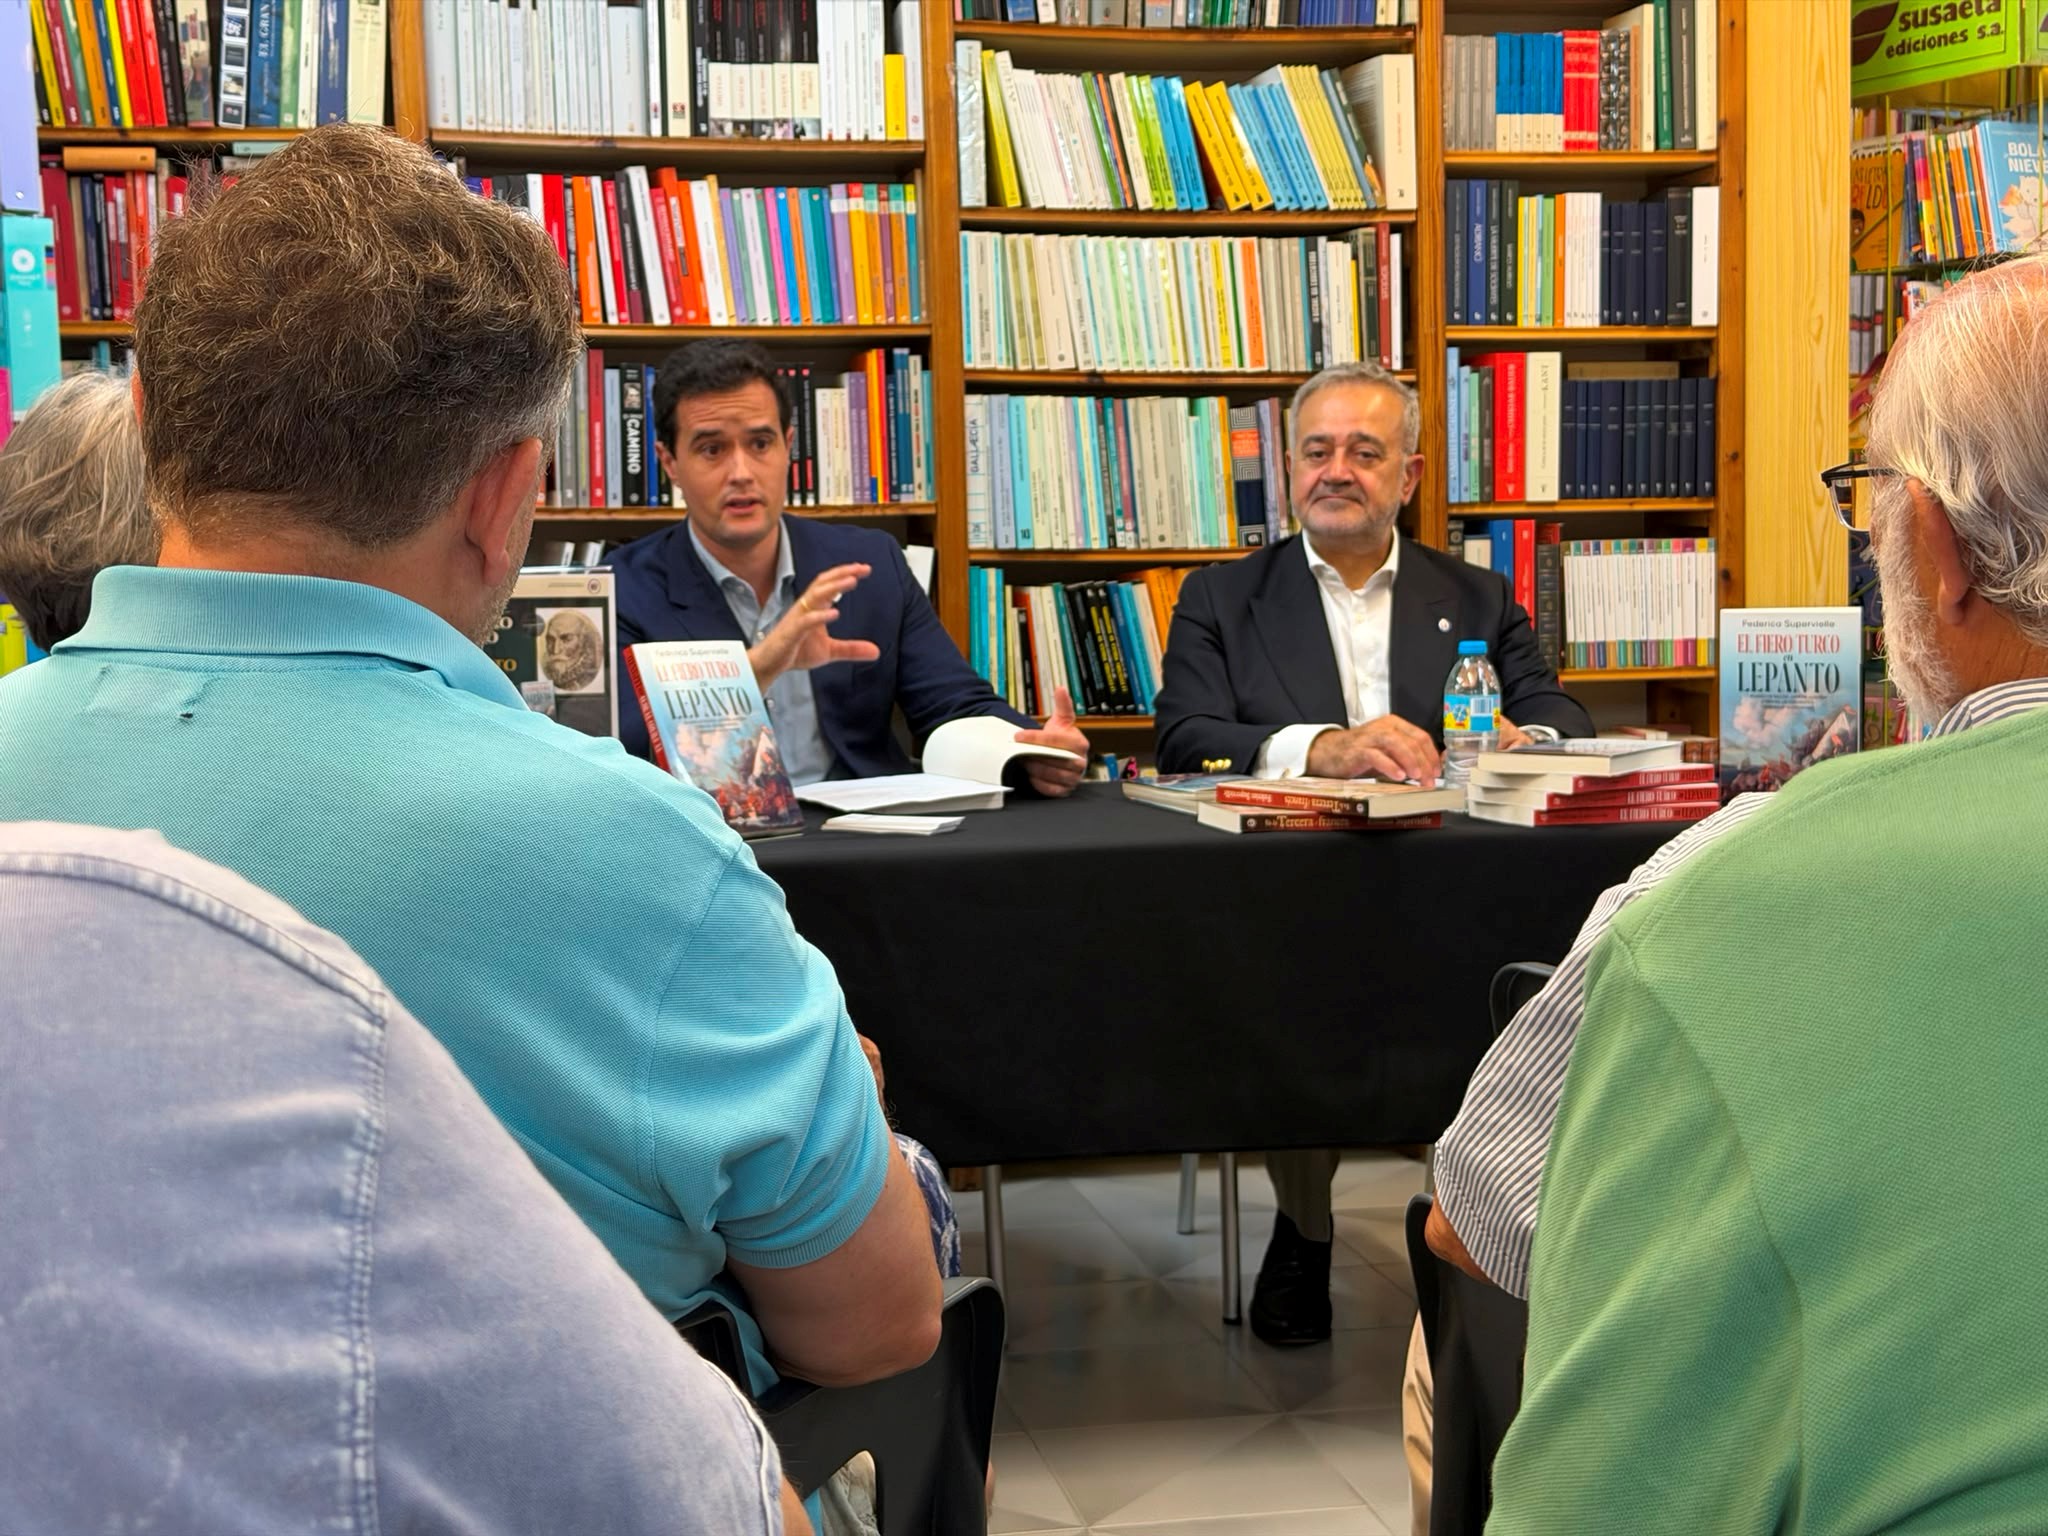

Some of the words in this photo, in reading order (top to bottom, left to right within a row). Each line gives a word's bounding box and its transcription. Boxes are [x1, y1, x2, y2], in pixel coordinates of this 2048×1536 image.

[1898, 0, 2002, 32] susaeta
[1885, 28, 1969, 59] ediciones
[1976, 21, 2005, 40] s.a.
[626, 418, 642, 475] CAMINO
[1742, 619, 1781, 627] Federico
[1737, 633, 1753, 654] EL
[1755, 633, 1793, 654] FIERO
[1795, 633, 1841, 654] TURCO
[1737, 661, 1841, 694] LEPANTO
[663, 686, 753, 720] LEPANTO
